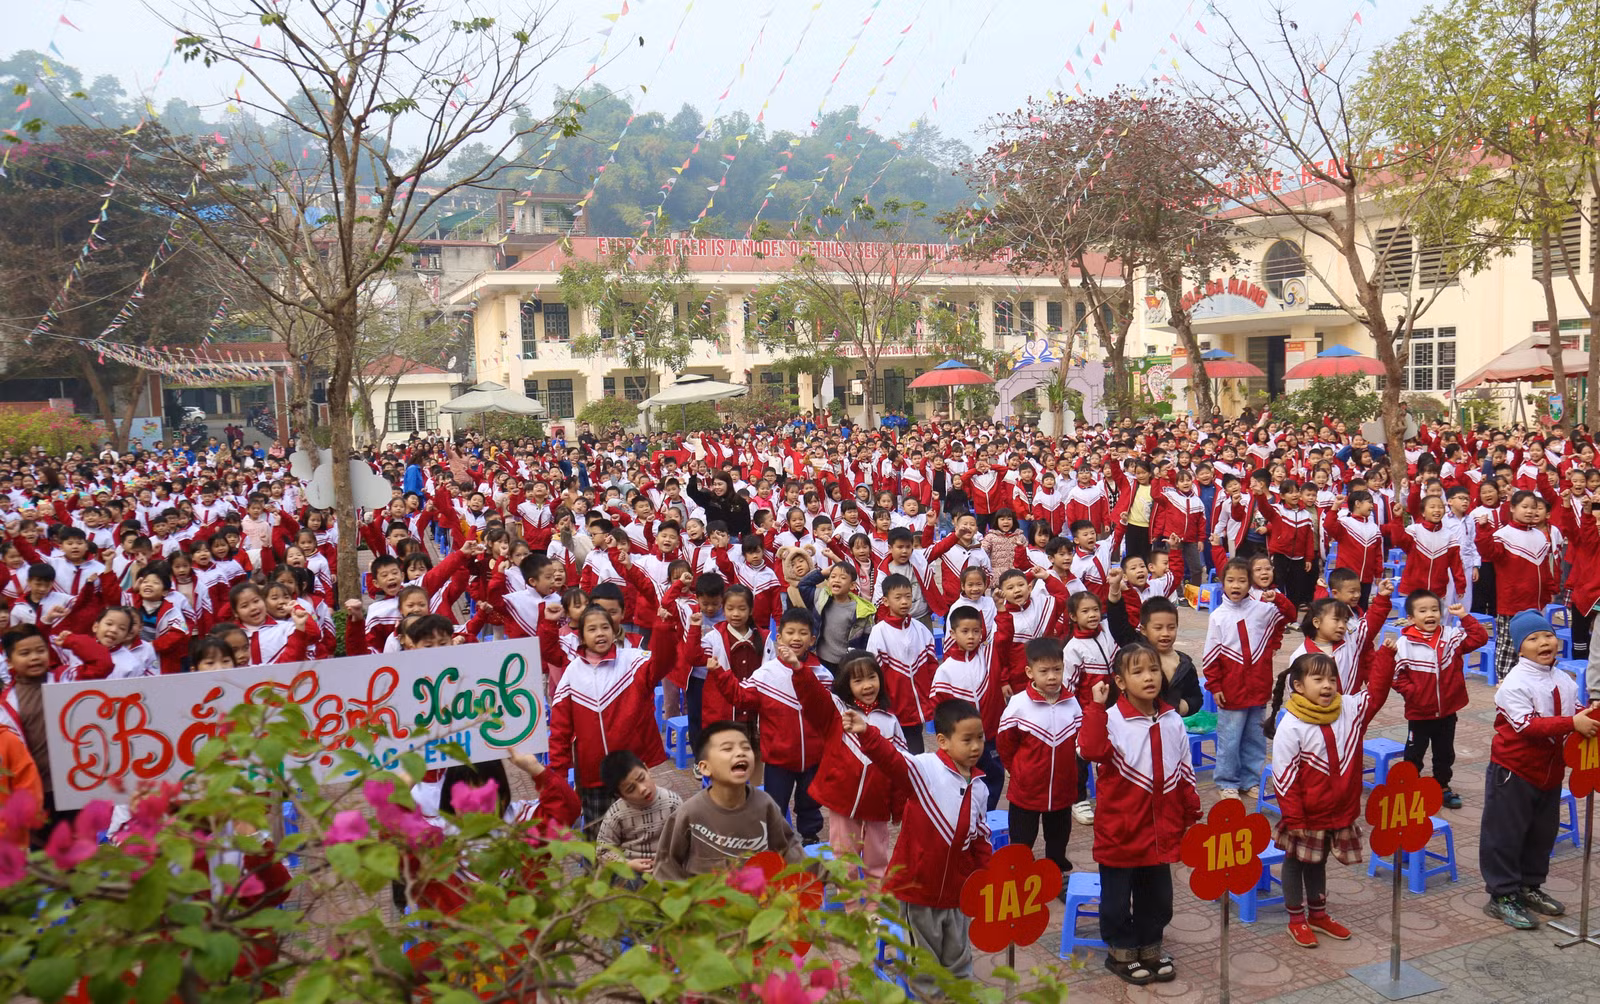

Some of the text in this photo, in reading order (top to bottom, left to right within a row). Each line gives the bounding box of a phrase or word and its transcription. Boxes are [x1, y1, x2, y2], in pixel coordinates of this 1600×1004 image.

[710, 239, 725, 257] IS
[729, 239, 739, 257] A
[742, 239, 786, 257] MODEL
[789, 240, 808, 257] OF
[808, 240, 851, 258] ETHICS
[855, 242, 885, 260] SELF
[413, 652, 542, 748] Xanh
[1378, 790, 1426, 830] 1A4
[1202, 828, 1253, 871] 1A3
[980, 875, 1042, 923] 1A2
